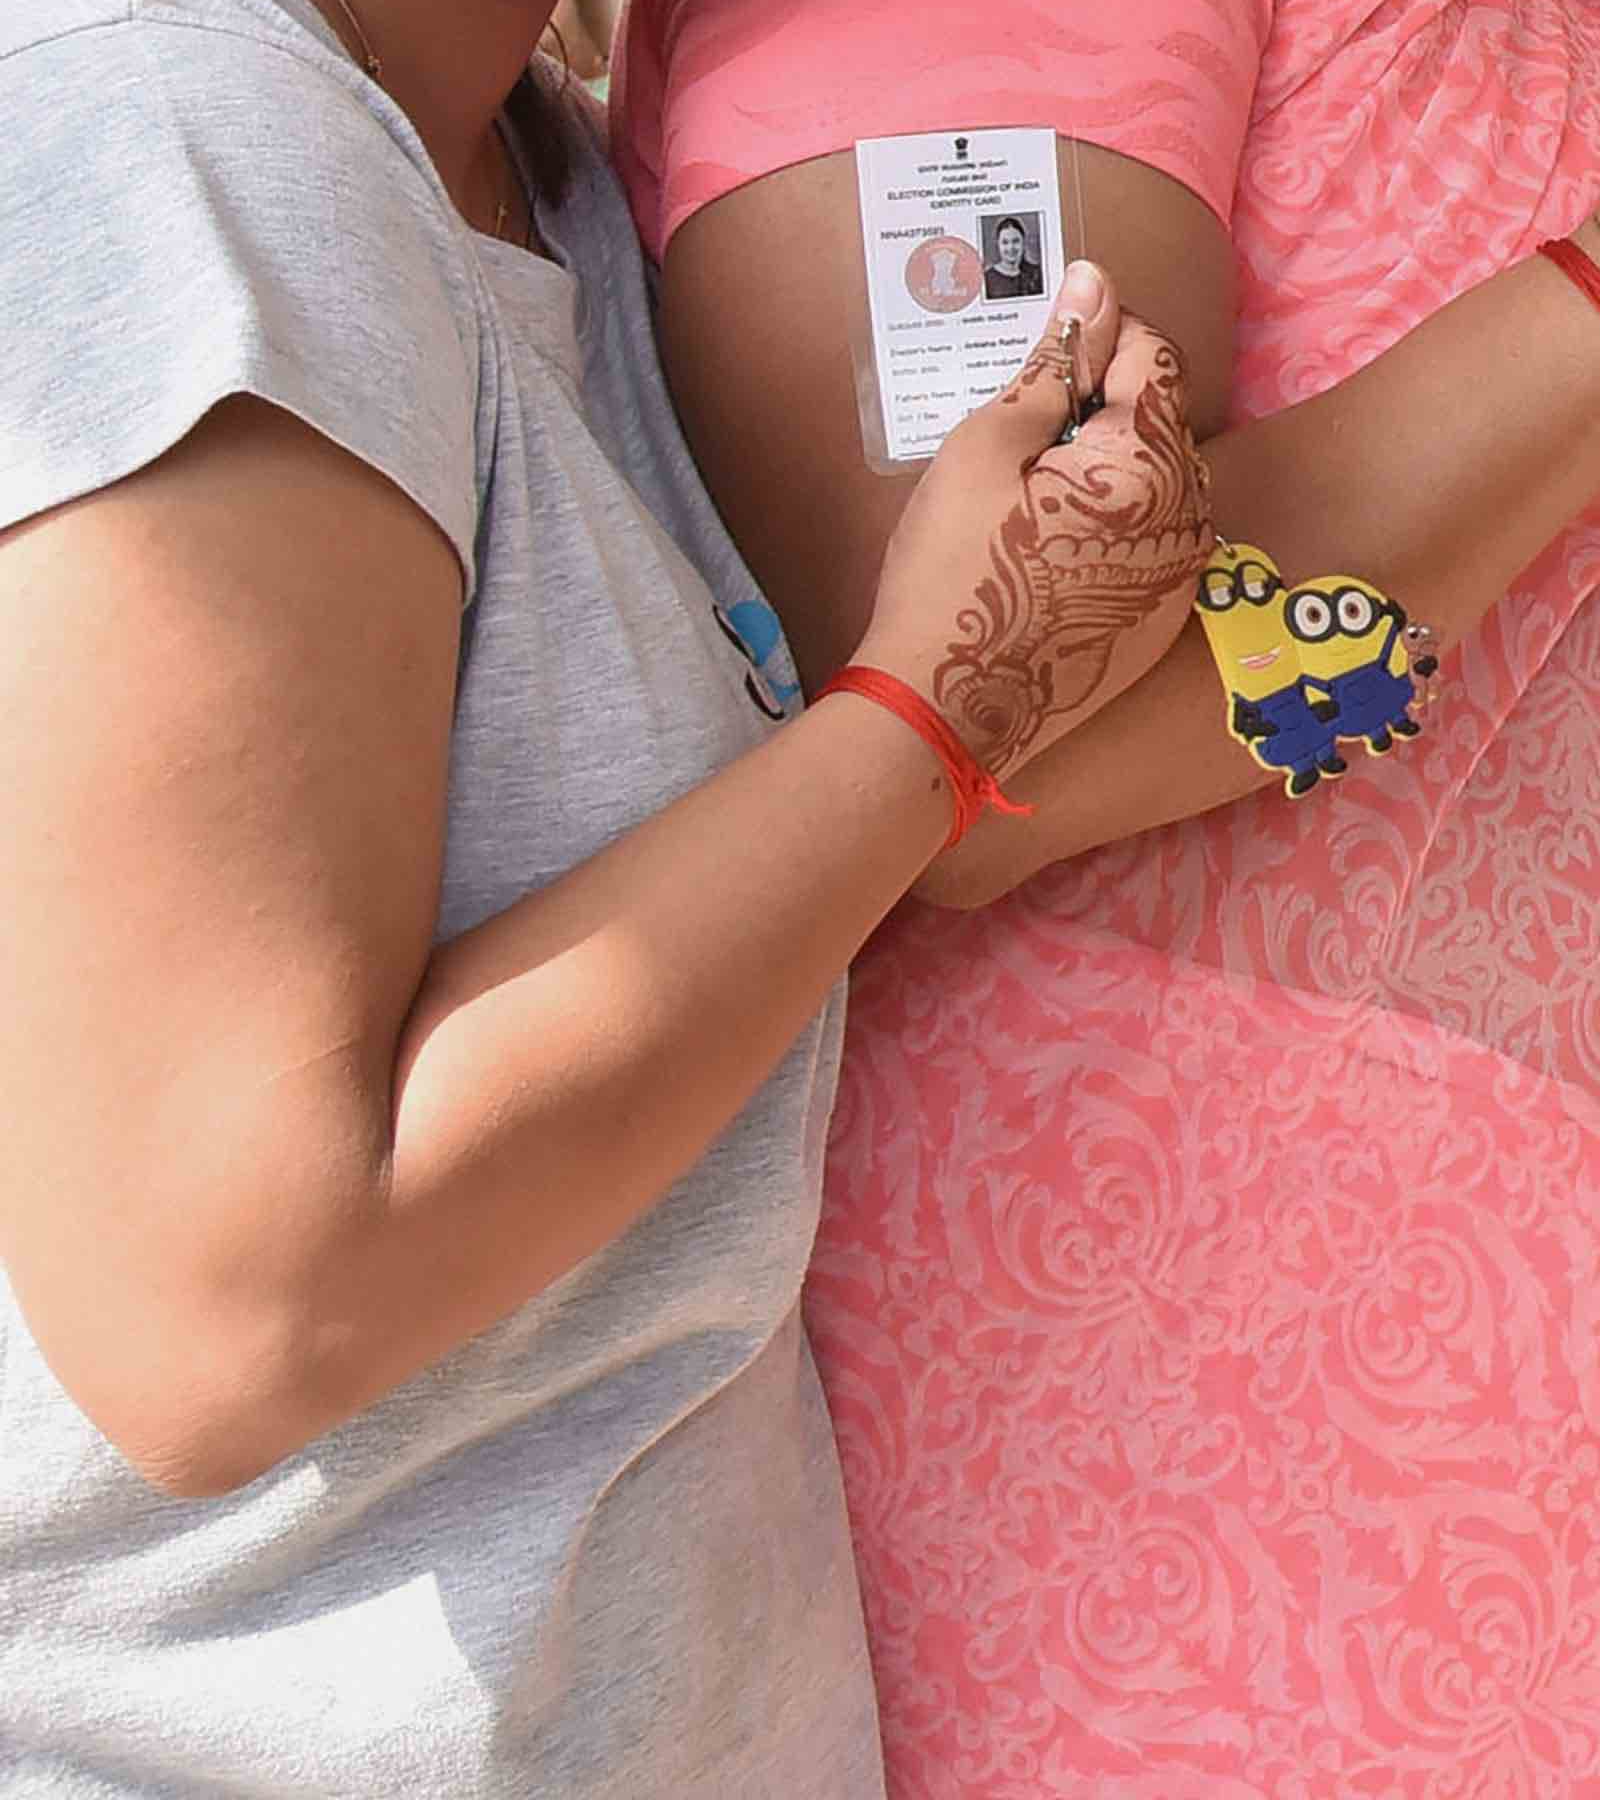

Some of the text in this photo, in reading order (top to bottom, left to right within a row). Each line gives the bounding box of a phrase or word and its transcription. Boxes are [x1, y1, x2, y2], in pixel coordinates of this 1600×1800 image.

[887, 189, 934, 201] ELECTION
[936, 185, 998, 198] COMMISSION
[1014, 180, 1040, 191] INDIA
